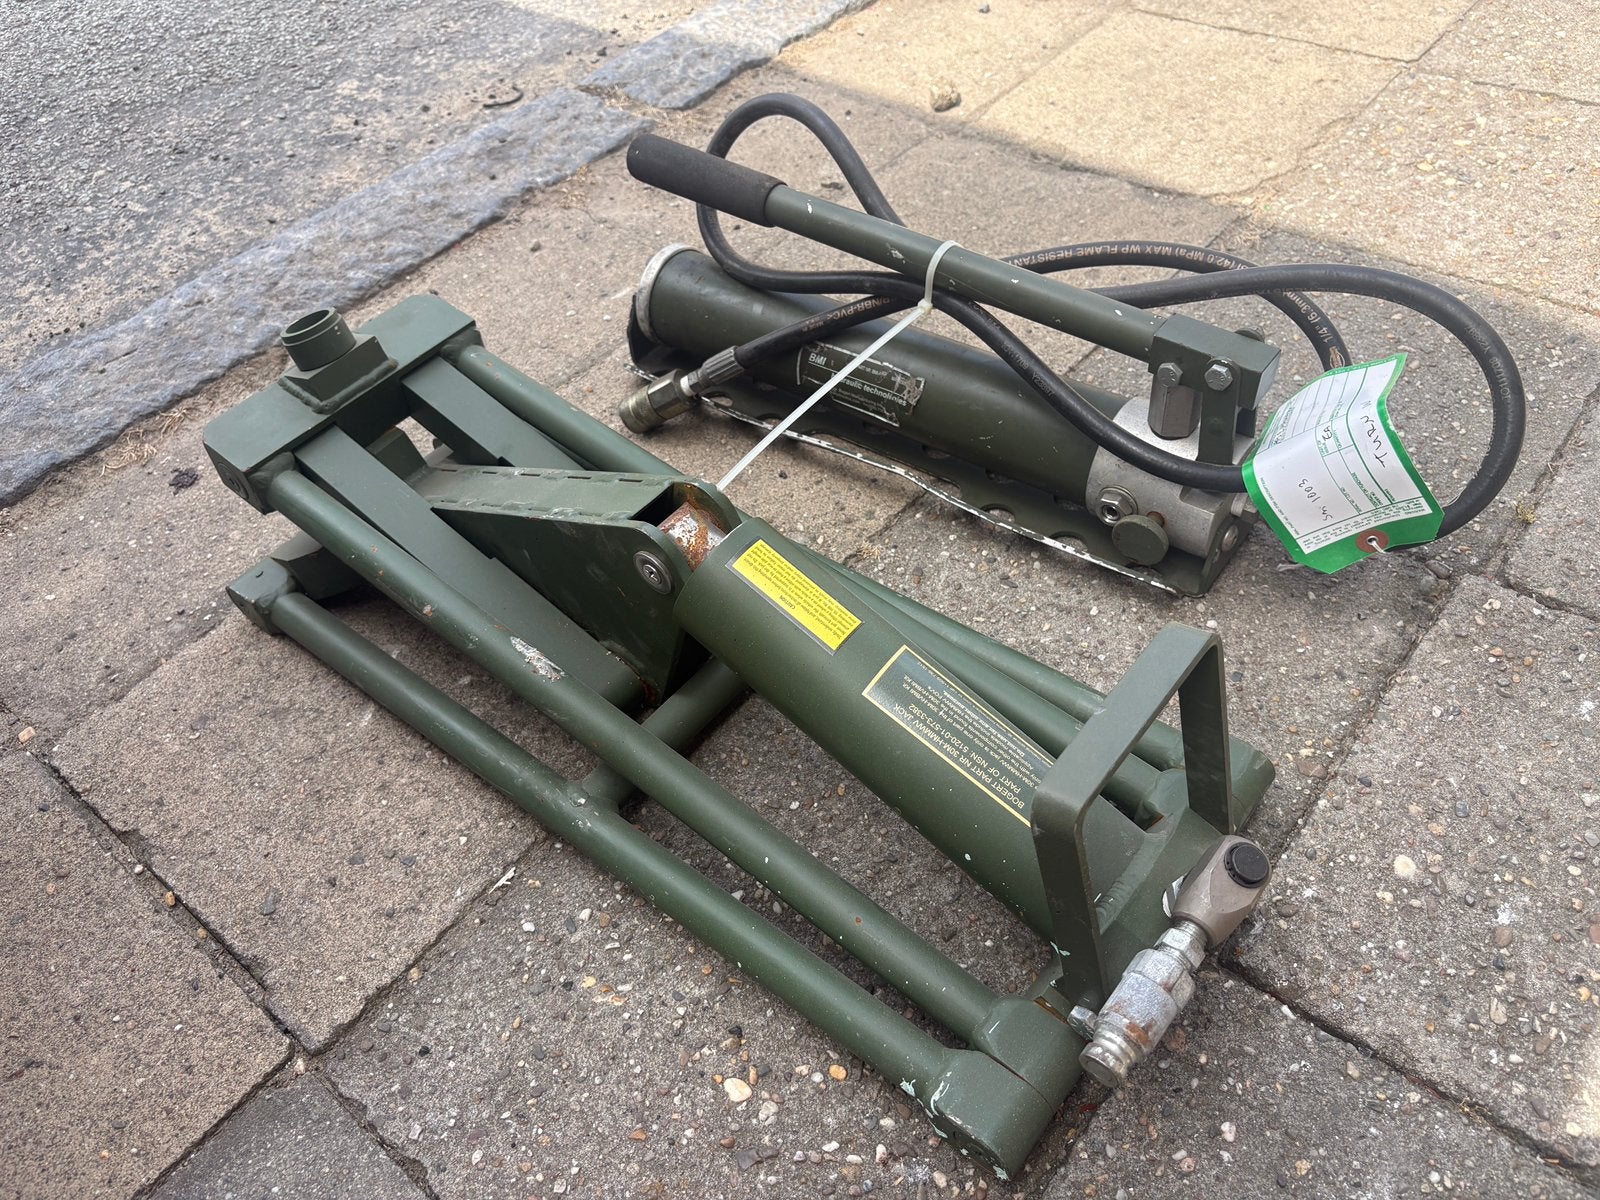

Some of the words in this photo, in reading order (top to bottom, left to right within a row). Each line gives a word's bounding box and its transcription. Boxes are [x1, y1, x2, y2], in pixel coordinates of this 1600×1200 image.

[1075, 244, 1117, 256] FLAME
[1120, 244, 1140, 253] WP
[1143, 240, 1172, 259] MAX
[1173, 244, 1205, 262] MPa)
[1205, 252, 1236, 270] (42.0
[807, 351, 827, 366] BMI
[829, 371, 863, 390] hraulic
[1360, 415, 1388, 468] TURN
[1296, 477, 1321, 503] 1003
[778, 594, 796, 610] CAUTION
[892, 702, 914, 722] JACK
[938, 702, 949, 711] the
[907, 702, 969, 753] 5120-01-573-3382
[946, 716, 953, 724] of
[951, 720, 964, 732] part
[952, 713, 968, 727] found
[911, 717, 960, 758] 30M-HMMWV
[962, 728, 974, 739] one
[967, 723, 998, 749] components
[972, 736, 986, 748] only
[957, 754, 972, 767] NR
[967, 749, 988, 768] NSN:
[988, 748, 1001, 761] jack
[996, 747, 1011, 760] other
[1009, 758, 1020, 767] the
[1018, 764, 1031, 776] with
[969, 763, 993, 784] PART
[986, 764, 1001, 778] OF
[1029, 772, 1042, 784] only
[999, 774, 1021, 794] PART
[990, 779, 1025, 809] BOGERT
